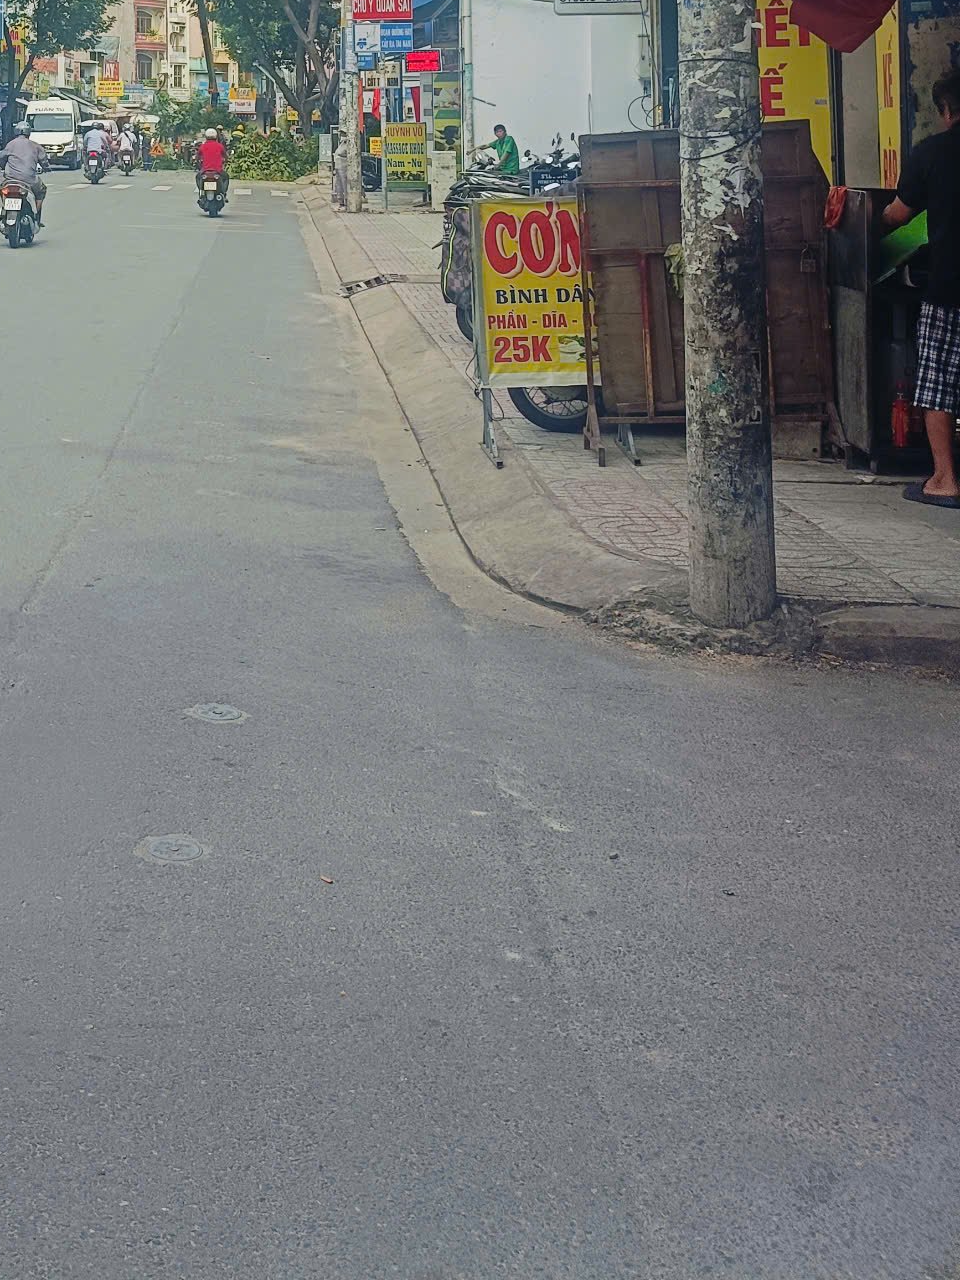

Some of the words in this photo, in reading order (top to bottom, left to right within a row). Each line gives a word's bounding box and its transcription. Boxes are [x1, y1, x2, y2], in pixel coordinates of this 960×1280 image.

[387, 158, 405, 168] Nam
[495, 284, 549, 305] BÌNH
[494, 335, 553, 363] 25K
